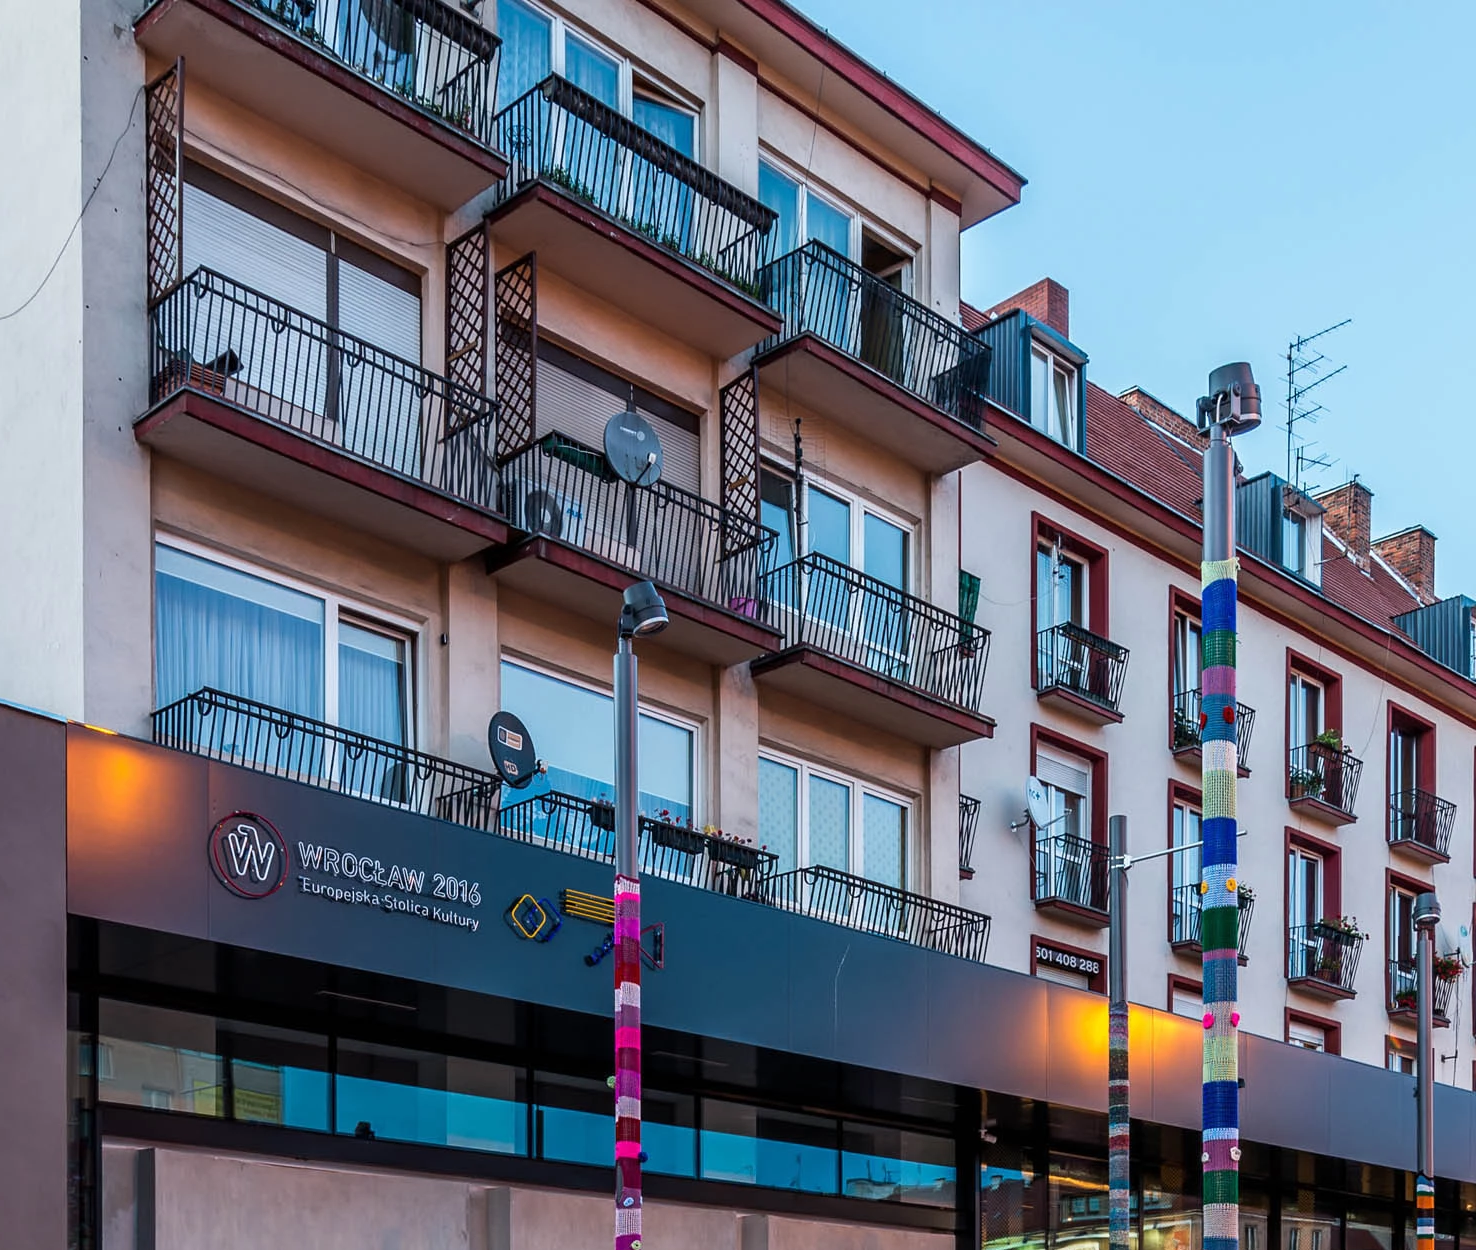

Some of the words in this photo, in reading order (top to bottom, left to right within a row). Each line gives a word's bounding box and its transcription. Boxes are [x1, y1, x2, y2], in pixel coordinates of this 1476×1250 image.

[298, 841, 425, 894] WROCŁAW
[433, 873, 482, 907] 2016
[302, 876, 379, 905] Europejska
[384, 895, 429, 917] Stolica
[433, 908, 479, 931] Kultury
[1056, 953, 1076, 968] 408
[1079, 959, 1100, 973] 288
